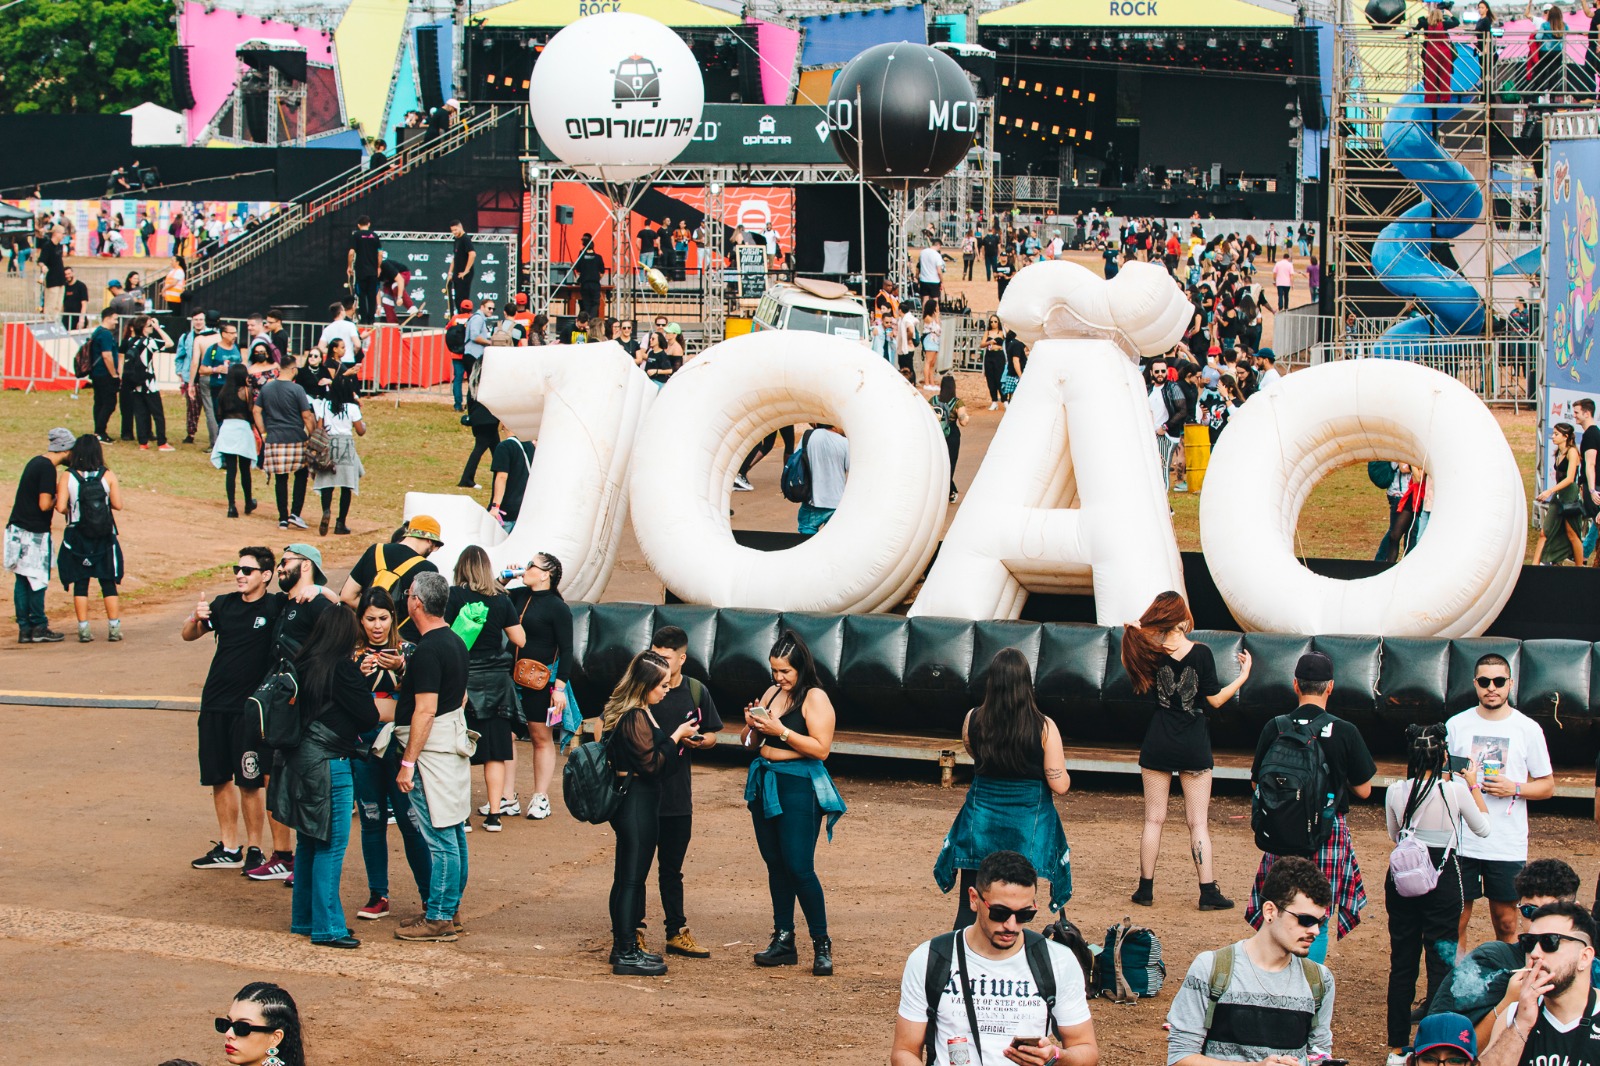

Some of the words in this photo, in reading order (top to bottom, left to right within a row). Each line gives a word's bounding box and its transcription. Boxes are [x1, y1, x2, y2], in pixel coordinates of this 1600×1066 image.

[579, 2, 621, 16] ROCK
[1109, 1, 1158, 16] ROCK
[826, 100, 852, 130] CD
[928, 99, 979, 132] MCD
[690, 121, 718, 141] CD
[405, 260, 1529, 638] JOÃO
[980, 1025, 1006, 1033] OFFICIAL
